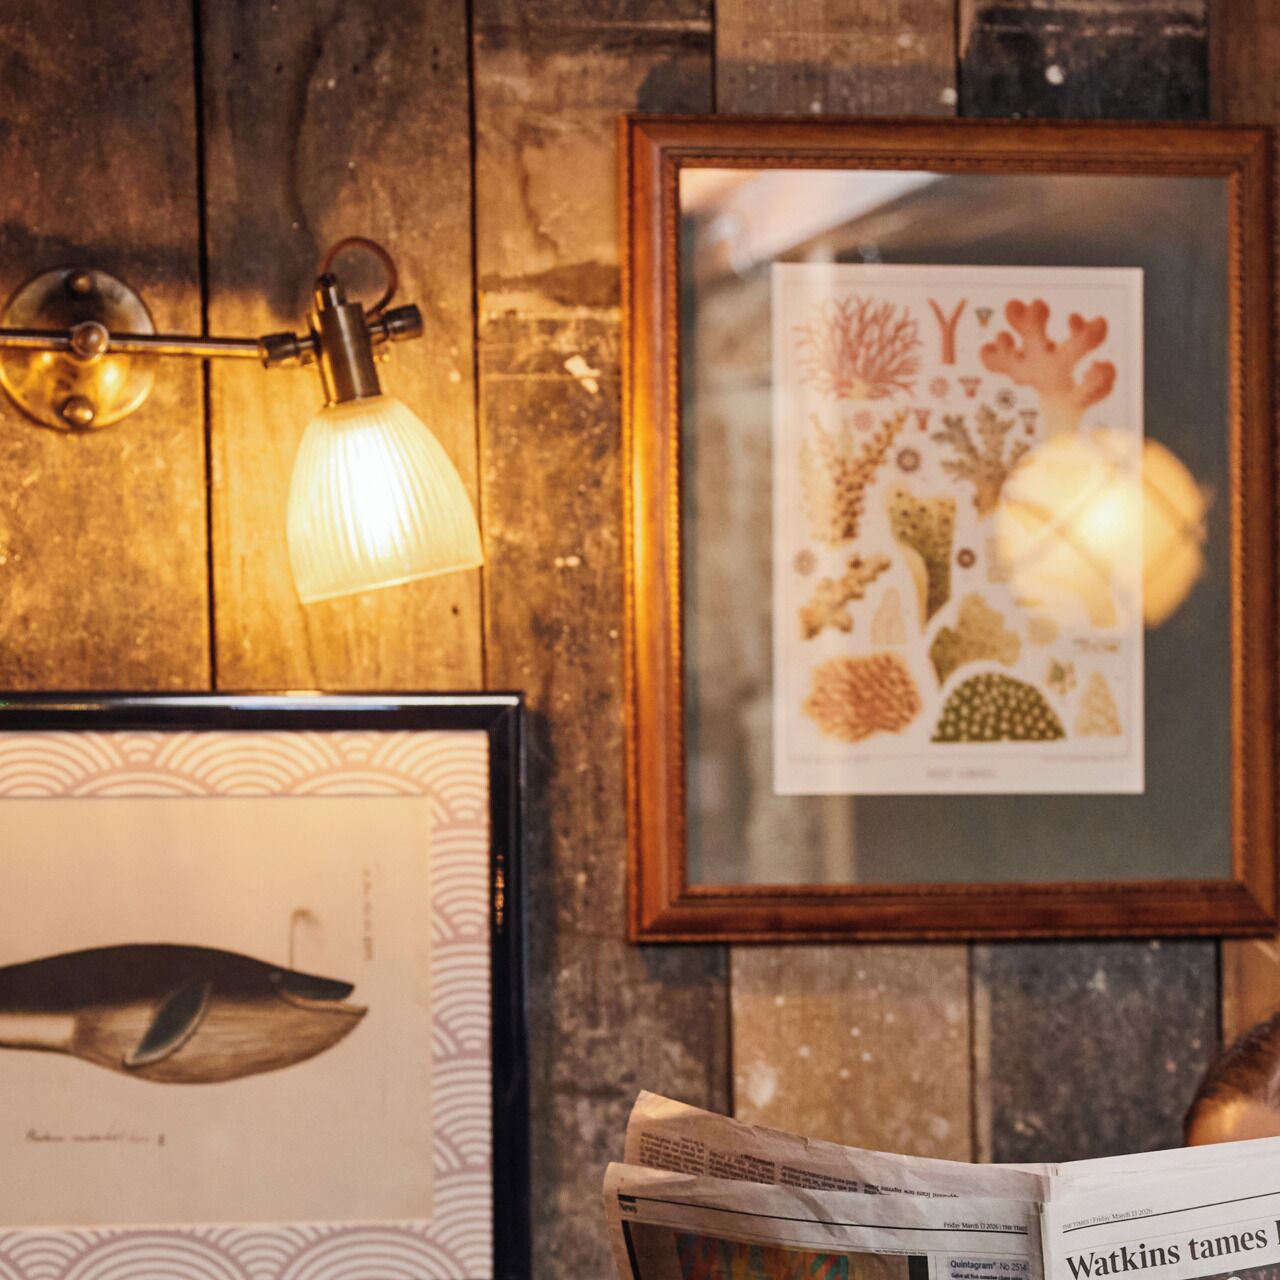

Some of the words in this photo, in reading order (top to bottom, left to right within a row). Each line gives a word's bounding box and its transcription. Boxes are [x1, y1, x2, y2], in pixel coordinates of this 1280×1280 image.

[1092, 1213, 1111, 1224] Friday
[1112, 1210, 1131, 1220] March
[944, 1222, 960, 1230] Friday
[1065, 1242, 1181, 1280] Watkins
[1187, 1229, 1268, 1261] tames
[1000, 1262, 1009, 1271] No
[1011, 1263, 1027, 1271] 2514
